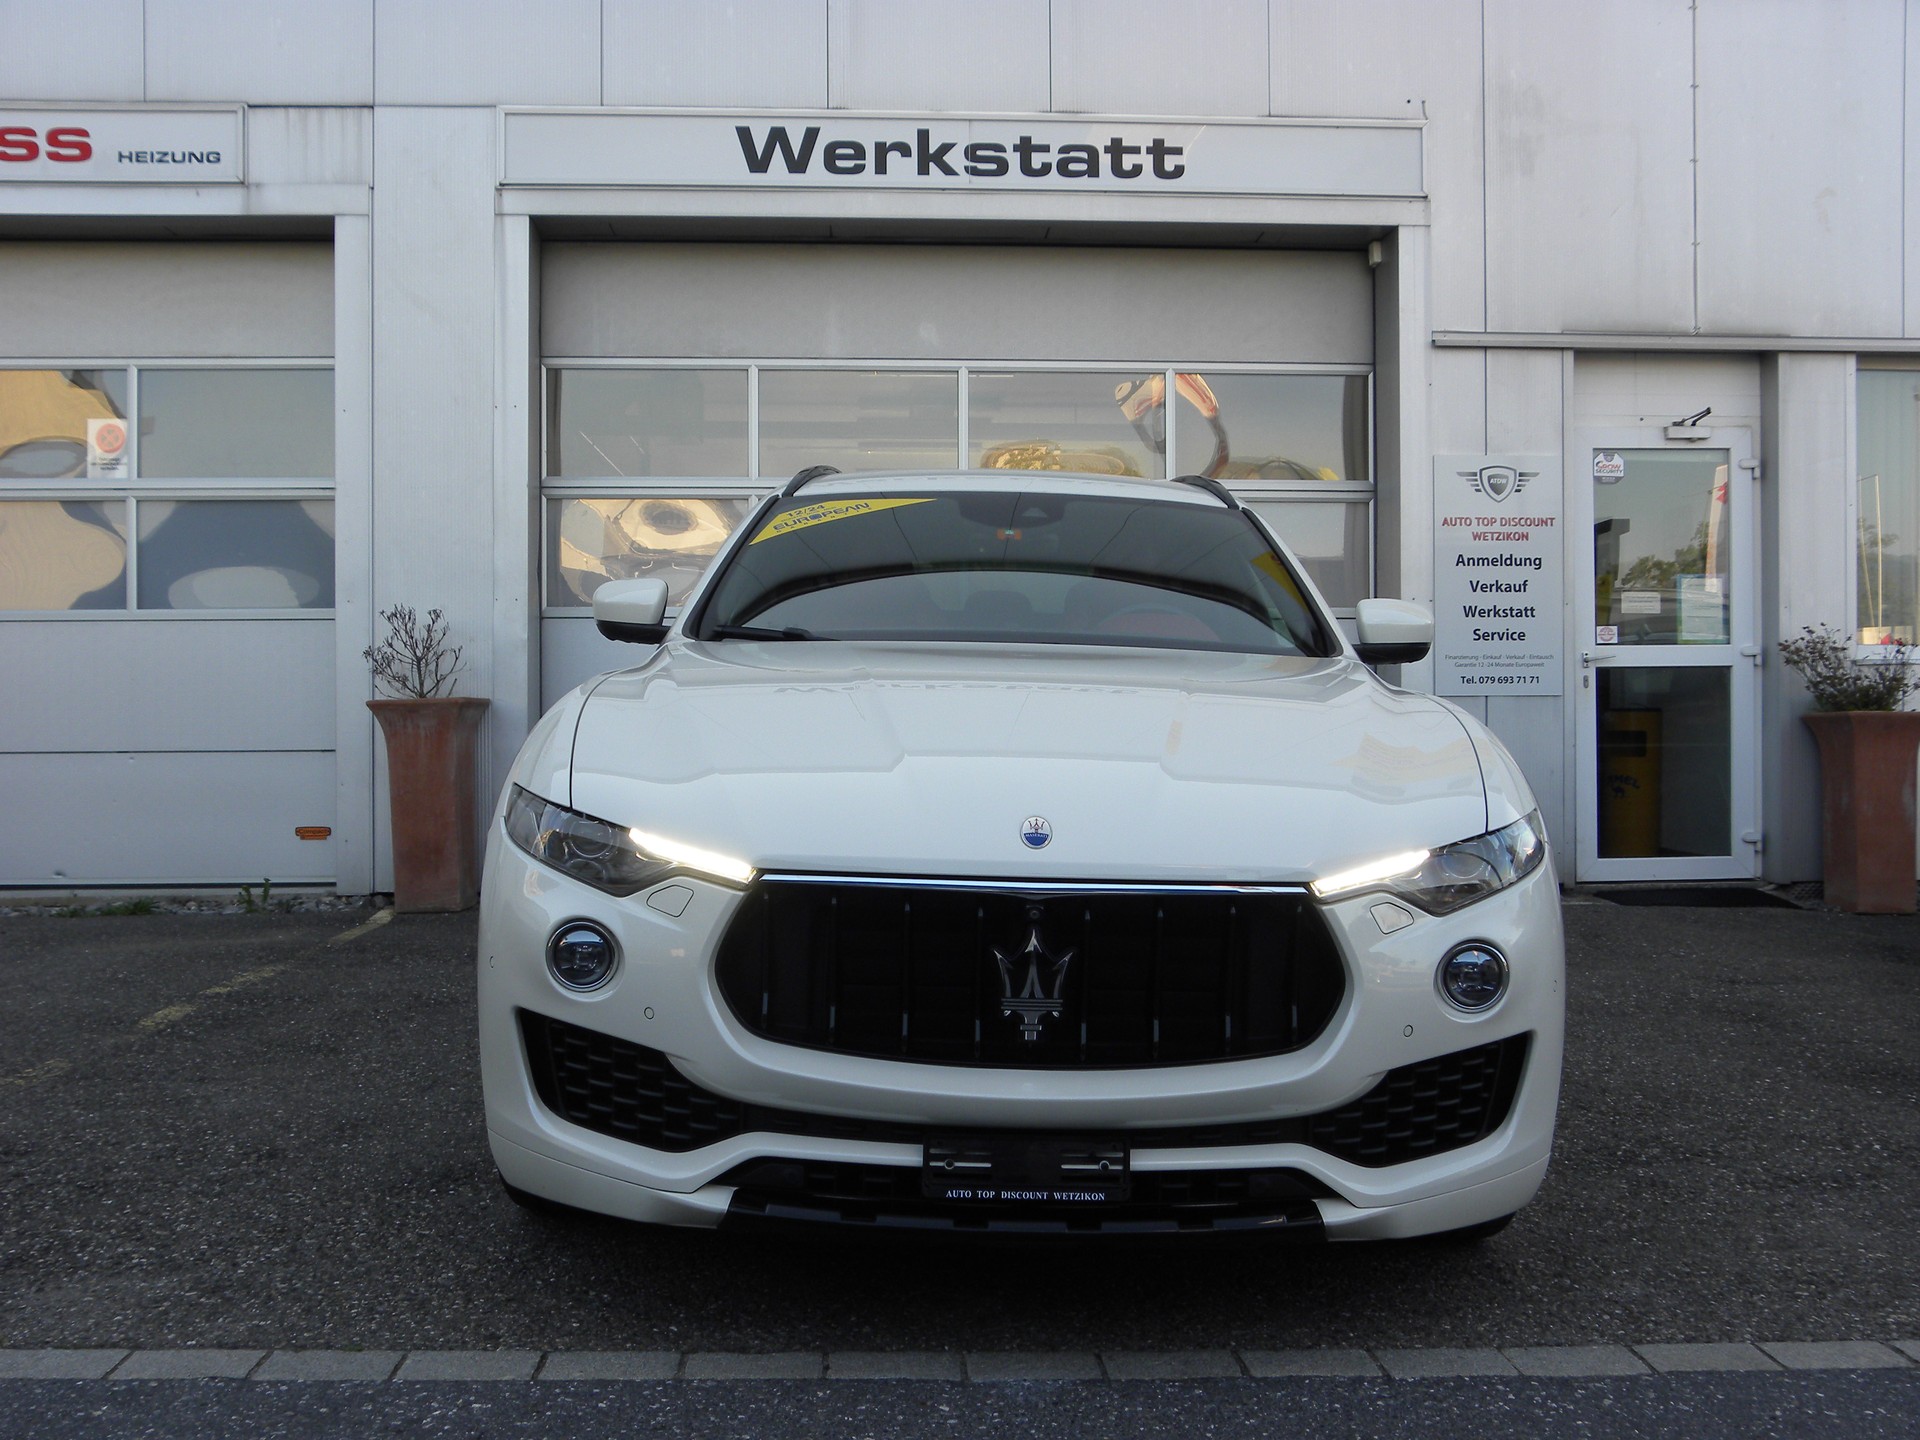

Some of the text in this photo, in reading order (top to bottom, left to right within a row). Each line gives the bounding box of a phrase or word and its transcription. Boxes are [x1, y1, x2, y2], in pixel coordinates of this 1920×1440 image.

[118, 151, 221, 164] HEIZUNG
[735, 125, 1185, 180] Werkstatt
[1442, 517, 1555, 527] AUTO TOP DISCOUNT
[1472, 532, 1529, 541] WETZIKON
[1456, 554, 1542, 570] Anmeldung
[1469, 580, 1528, 593] Verkauf
[1463, 605, 1536, 618] Werkstatt
[1473, 628, 1526, 641] Service
[1461, 676, 1540, 684] Tel. 079 693 71 71
[946, 1190, 1105, 1201] AUTO TOP DISCOUNT WETZIKON
